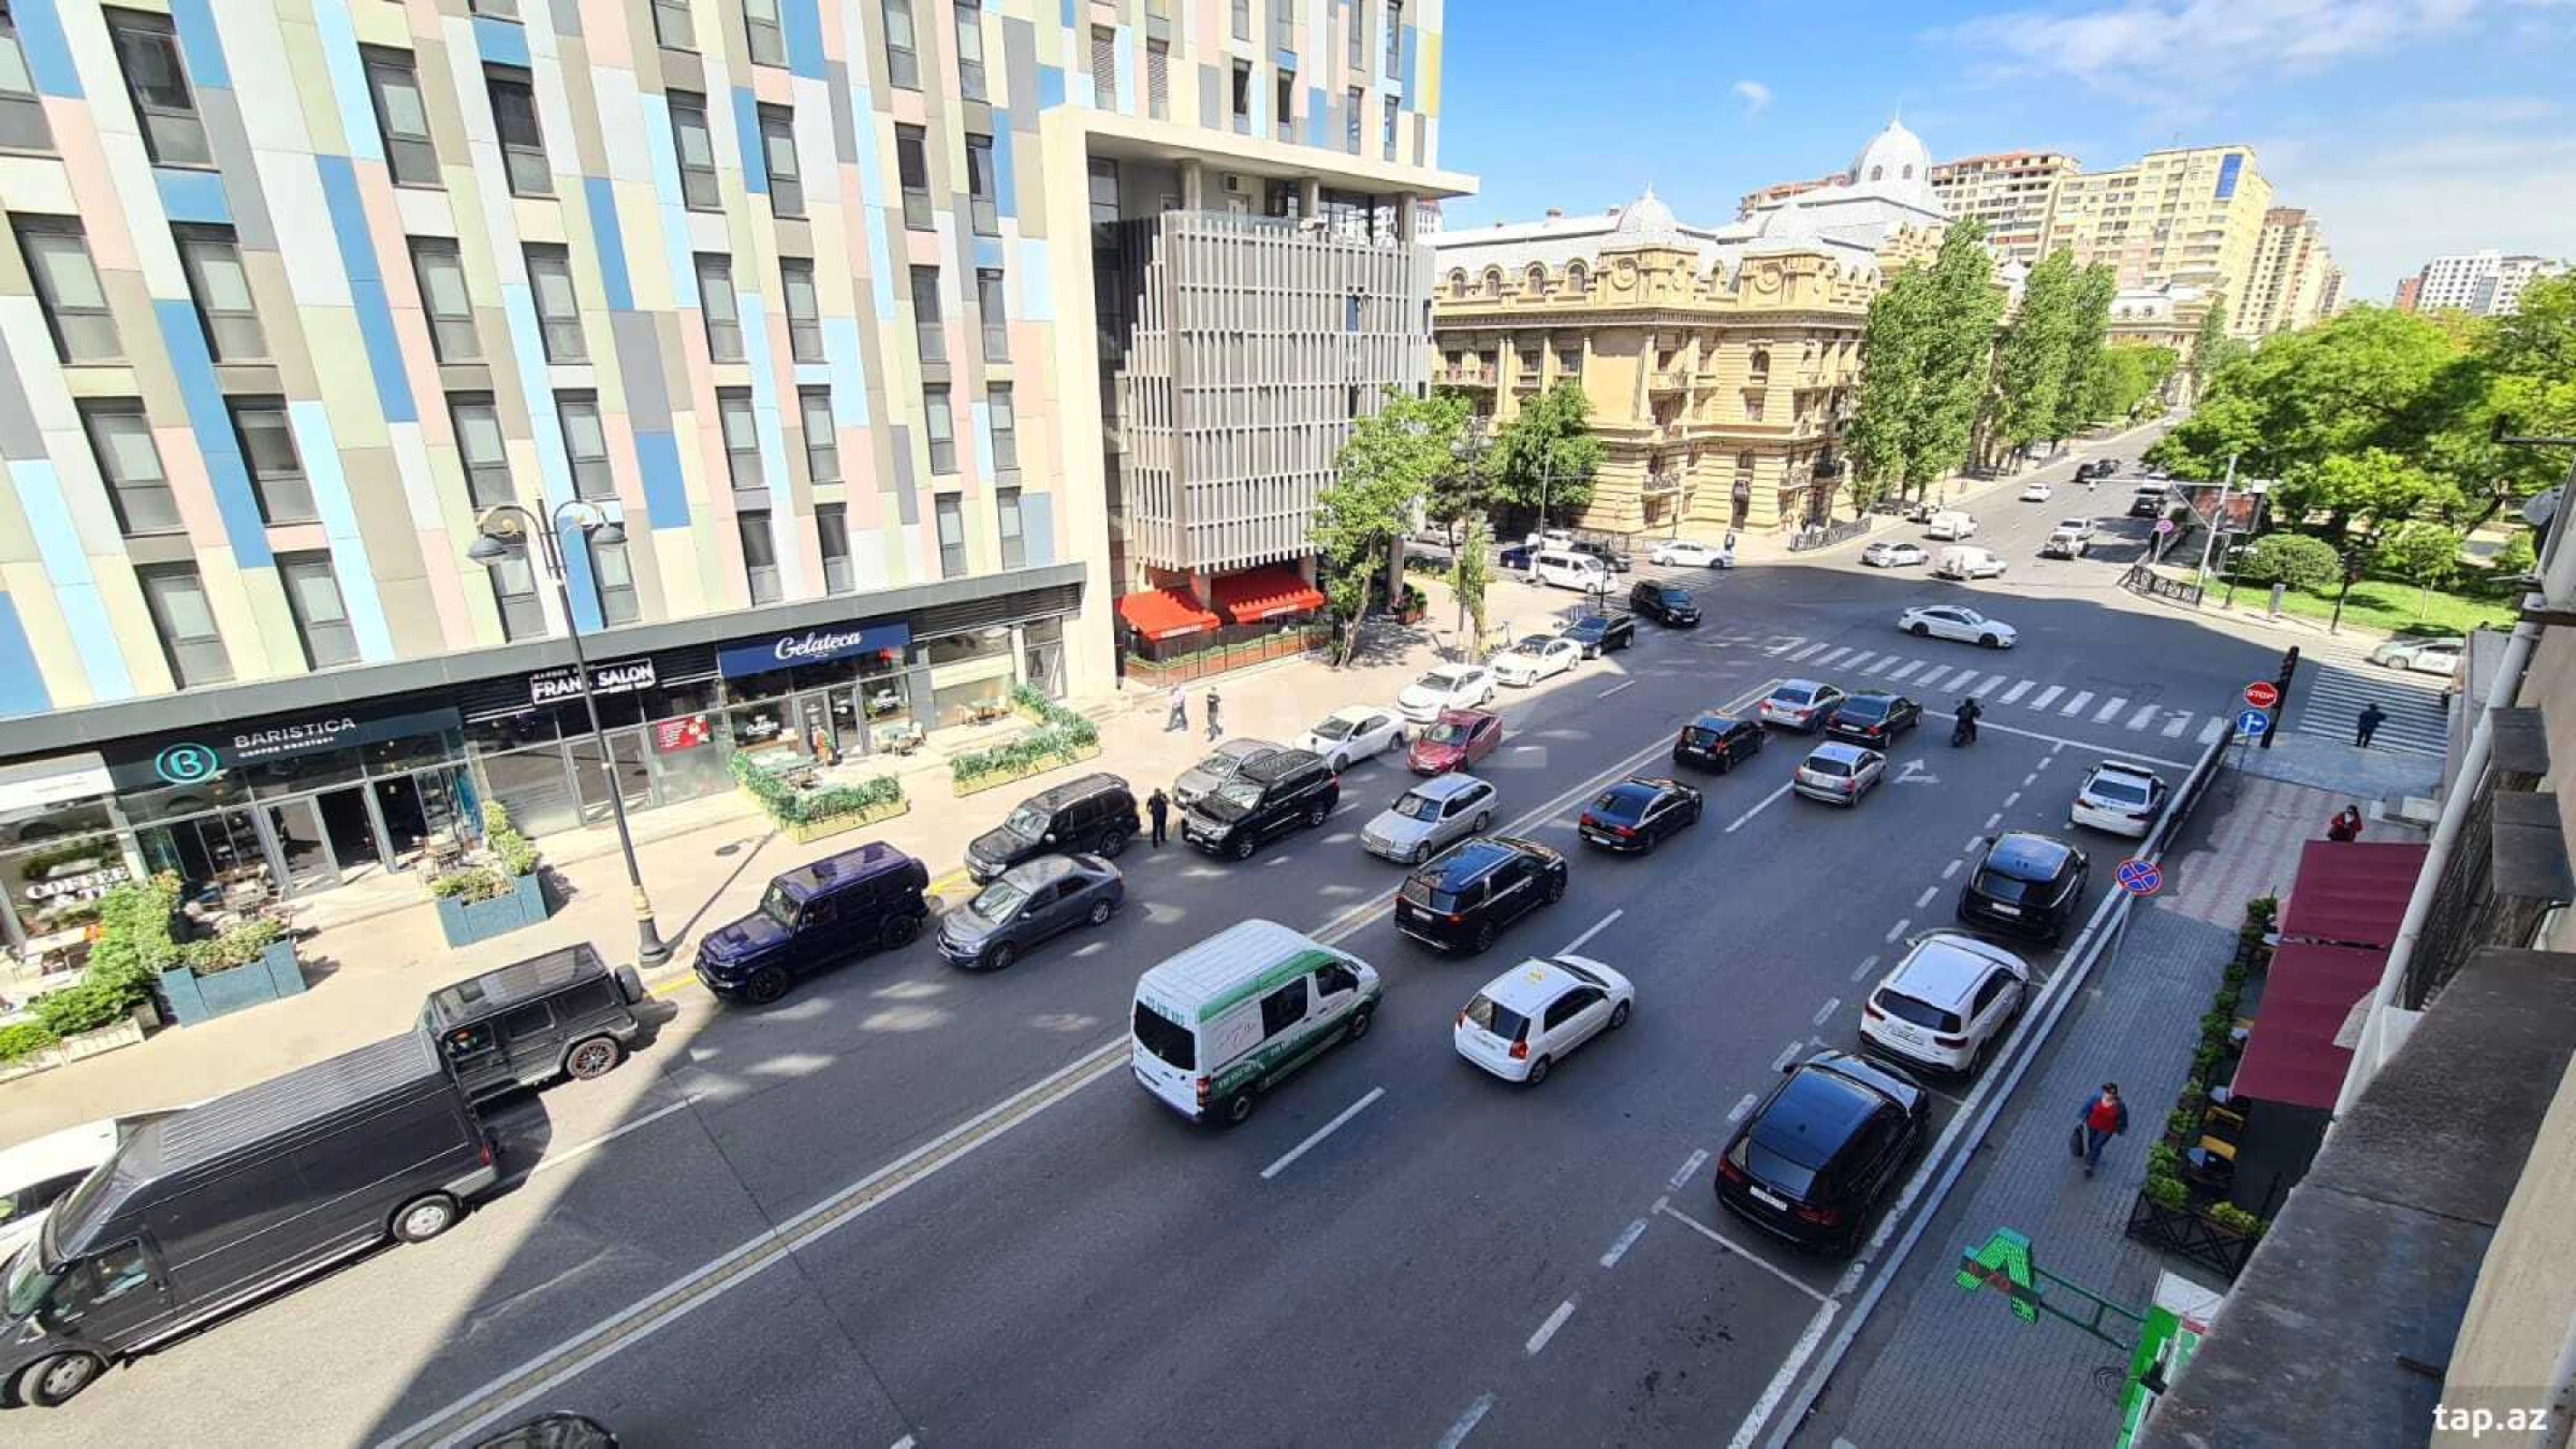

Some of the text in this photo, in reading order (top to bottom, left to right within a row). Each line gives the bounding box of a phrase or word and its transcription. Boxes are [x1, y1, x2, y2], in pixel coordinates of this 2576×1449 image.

[533, 676, 592, 703] FRAN
[598, 665, 653, 686] SALON
[2247, 689, 2274, 700] STOP
[234, 718, 355, 748] BARISTICA
